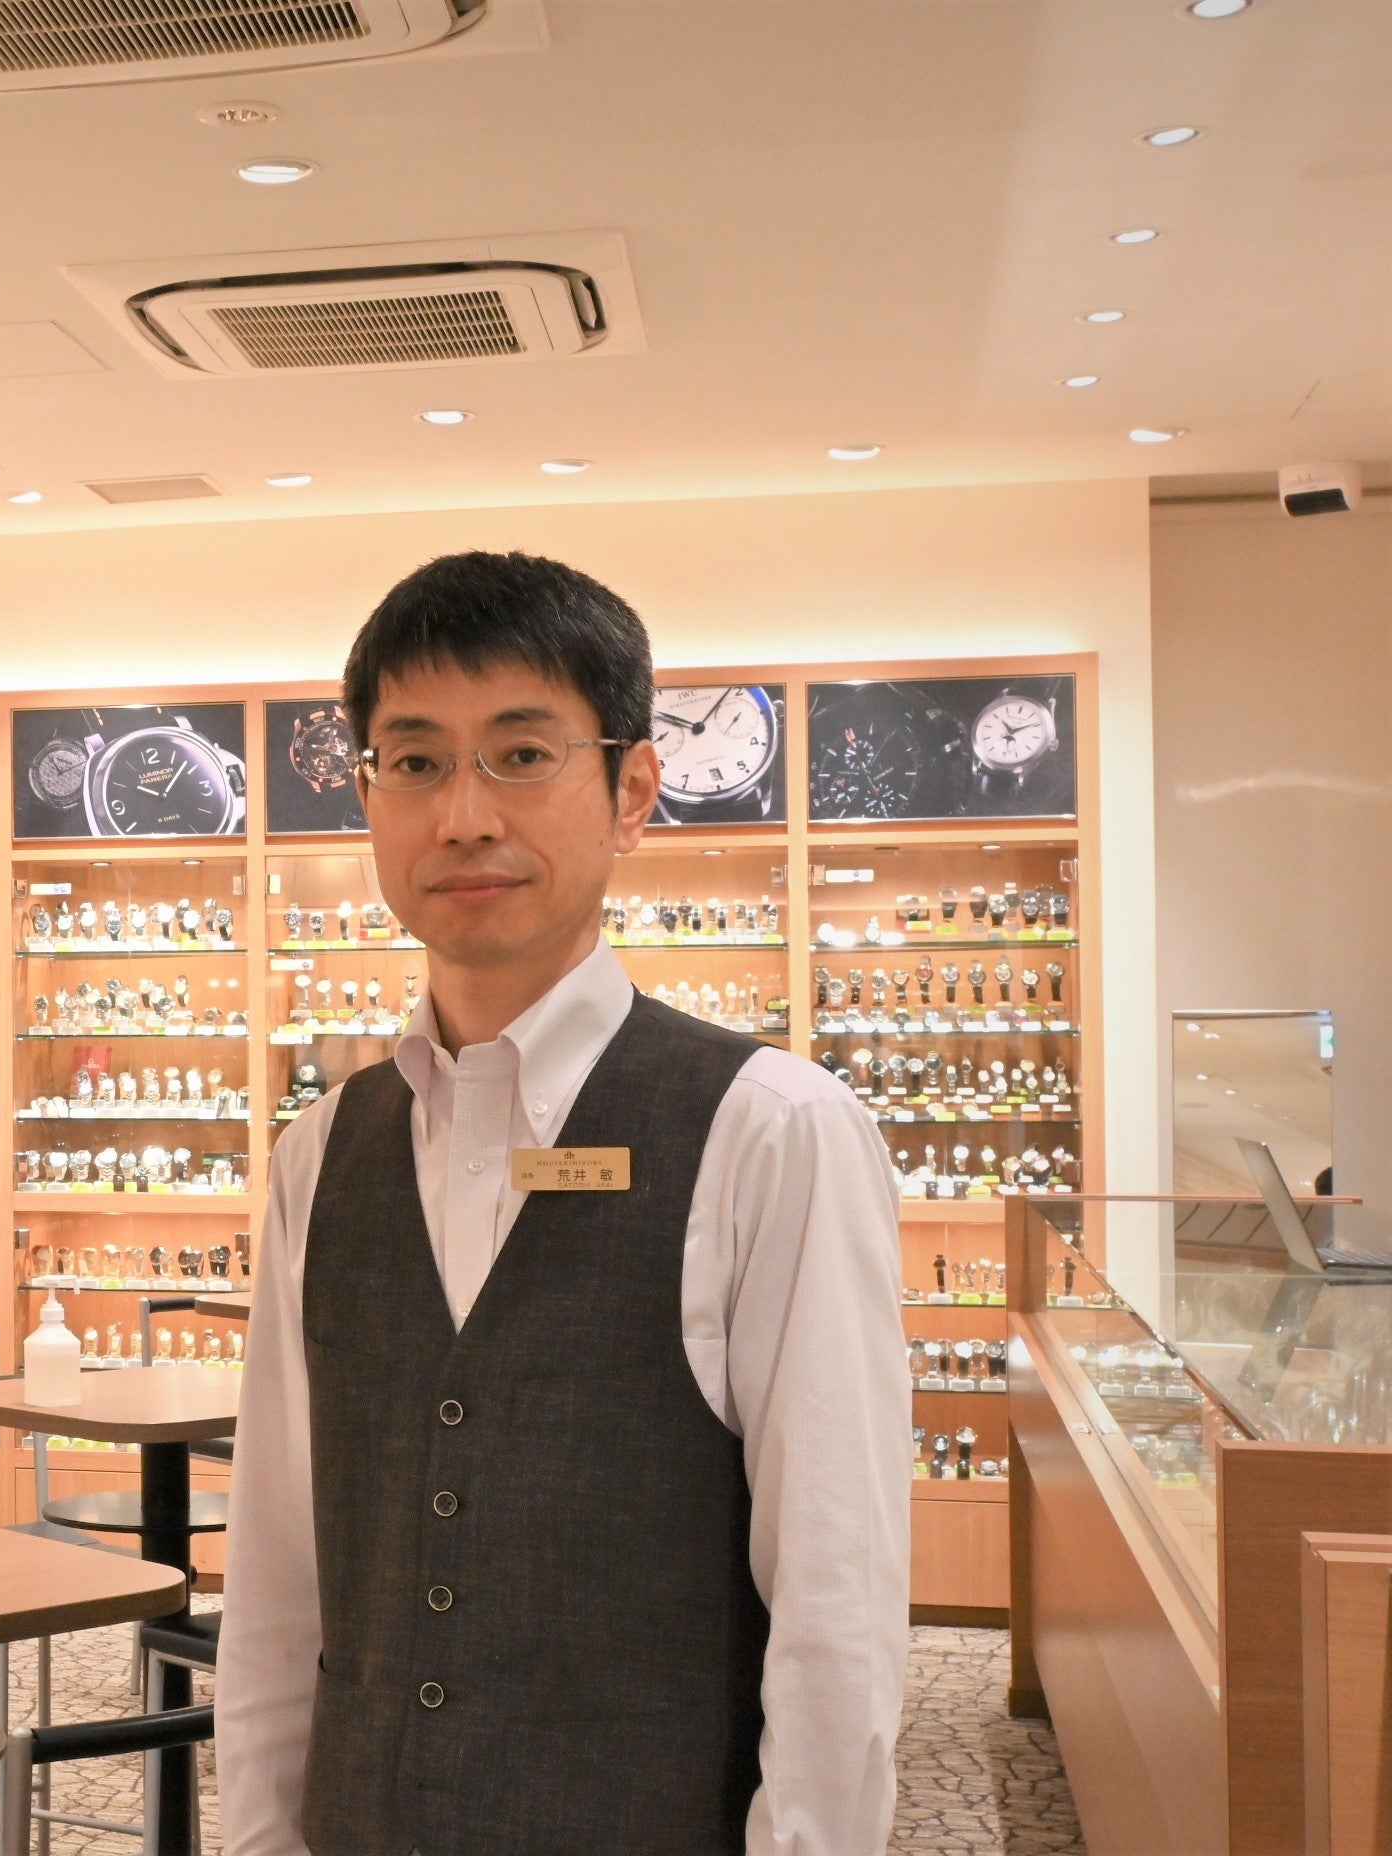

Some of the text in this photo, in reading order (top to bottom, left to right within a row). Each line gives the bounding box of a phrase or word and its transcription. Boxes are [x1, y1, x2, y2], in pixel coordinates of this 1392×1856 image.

[678, 690, 698, 700] IWC
[749, 736, 759, 746] 4
[736, 760, 747, 771] 5
[138, 767, 174, 780] LUMINOR
[198, 780, 214, 797] 3
[111, 799, 126, 816] 9
[558, 1168, 613, 1182] 荒井 敏
